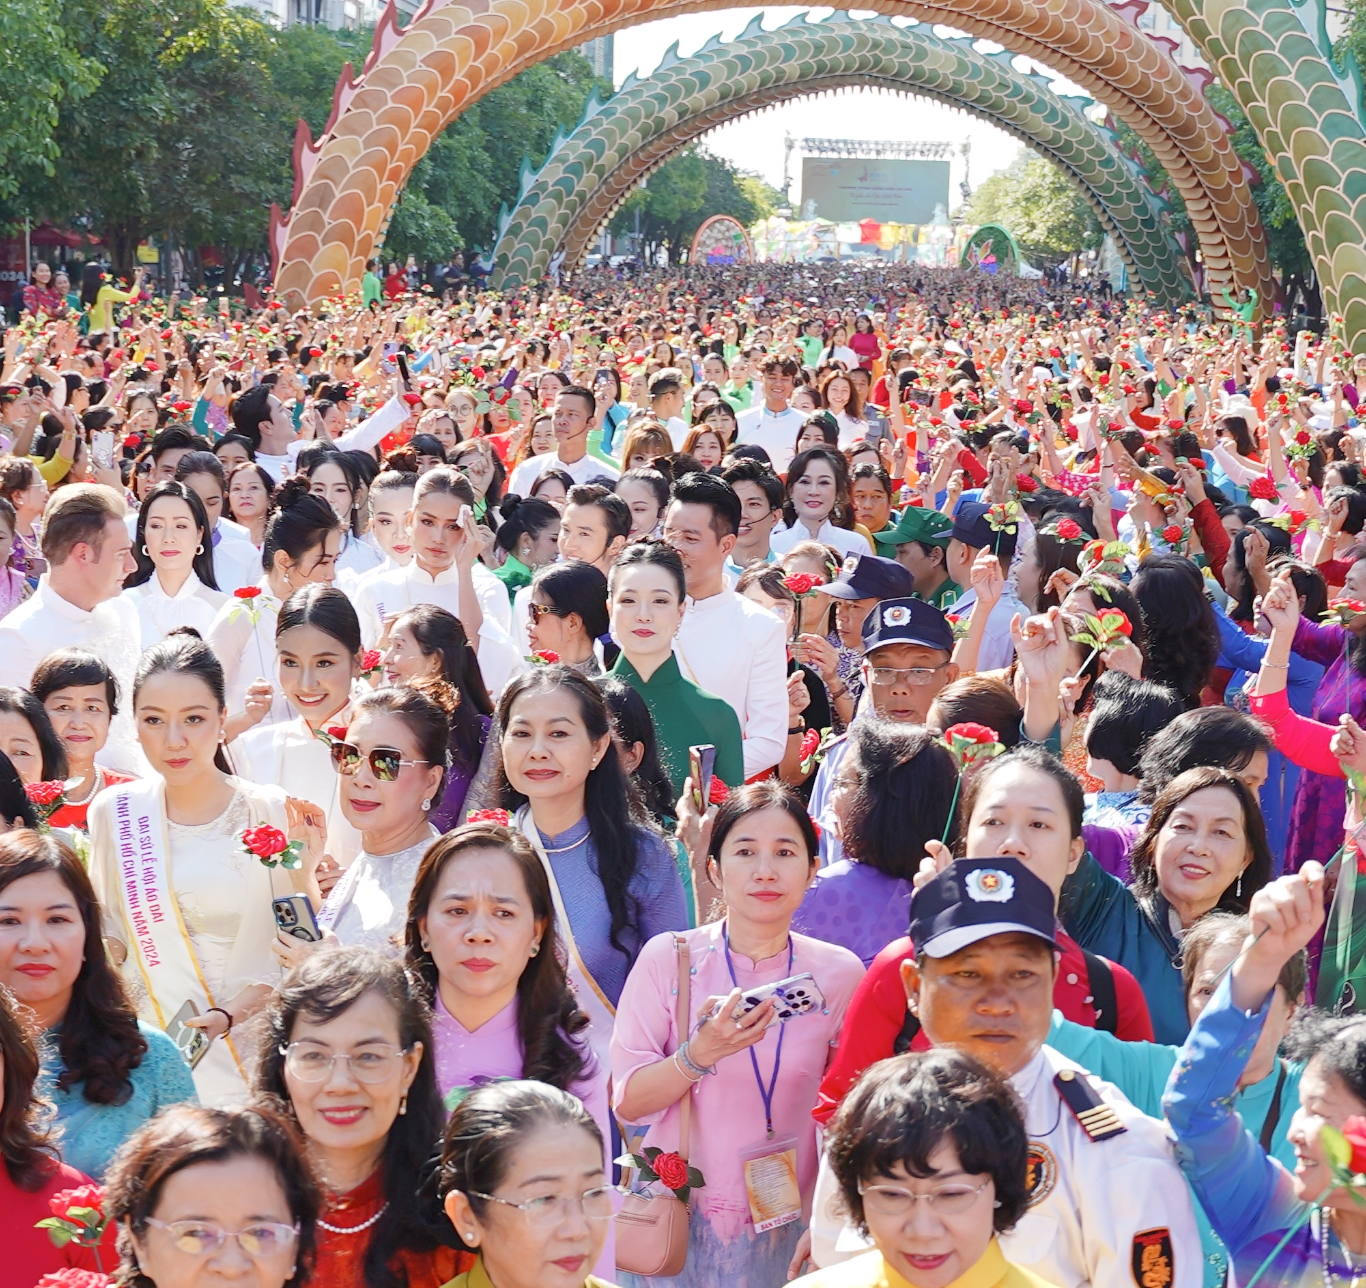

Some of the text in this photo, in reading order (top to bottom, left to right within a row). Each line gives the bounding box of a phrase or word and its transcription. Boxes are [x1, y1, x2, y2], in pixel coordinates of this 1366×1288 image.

[118, 819, 136, 841] PHỐ
[136, 816, 150, 834] ĐẠI
[120, 842, 138, 858] HỒ
[122, 860, 138, 879] CHÍ
[142, 867, 156, 885] HỘI
[125, 880, 141, 910] MINH
[145, 887, 158, 902] ÁO
[148, 904, 164, 923] DÀI
[131, 910, 150, 937] NĂM
[140, 937, 162, 967] 2024
